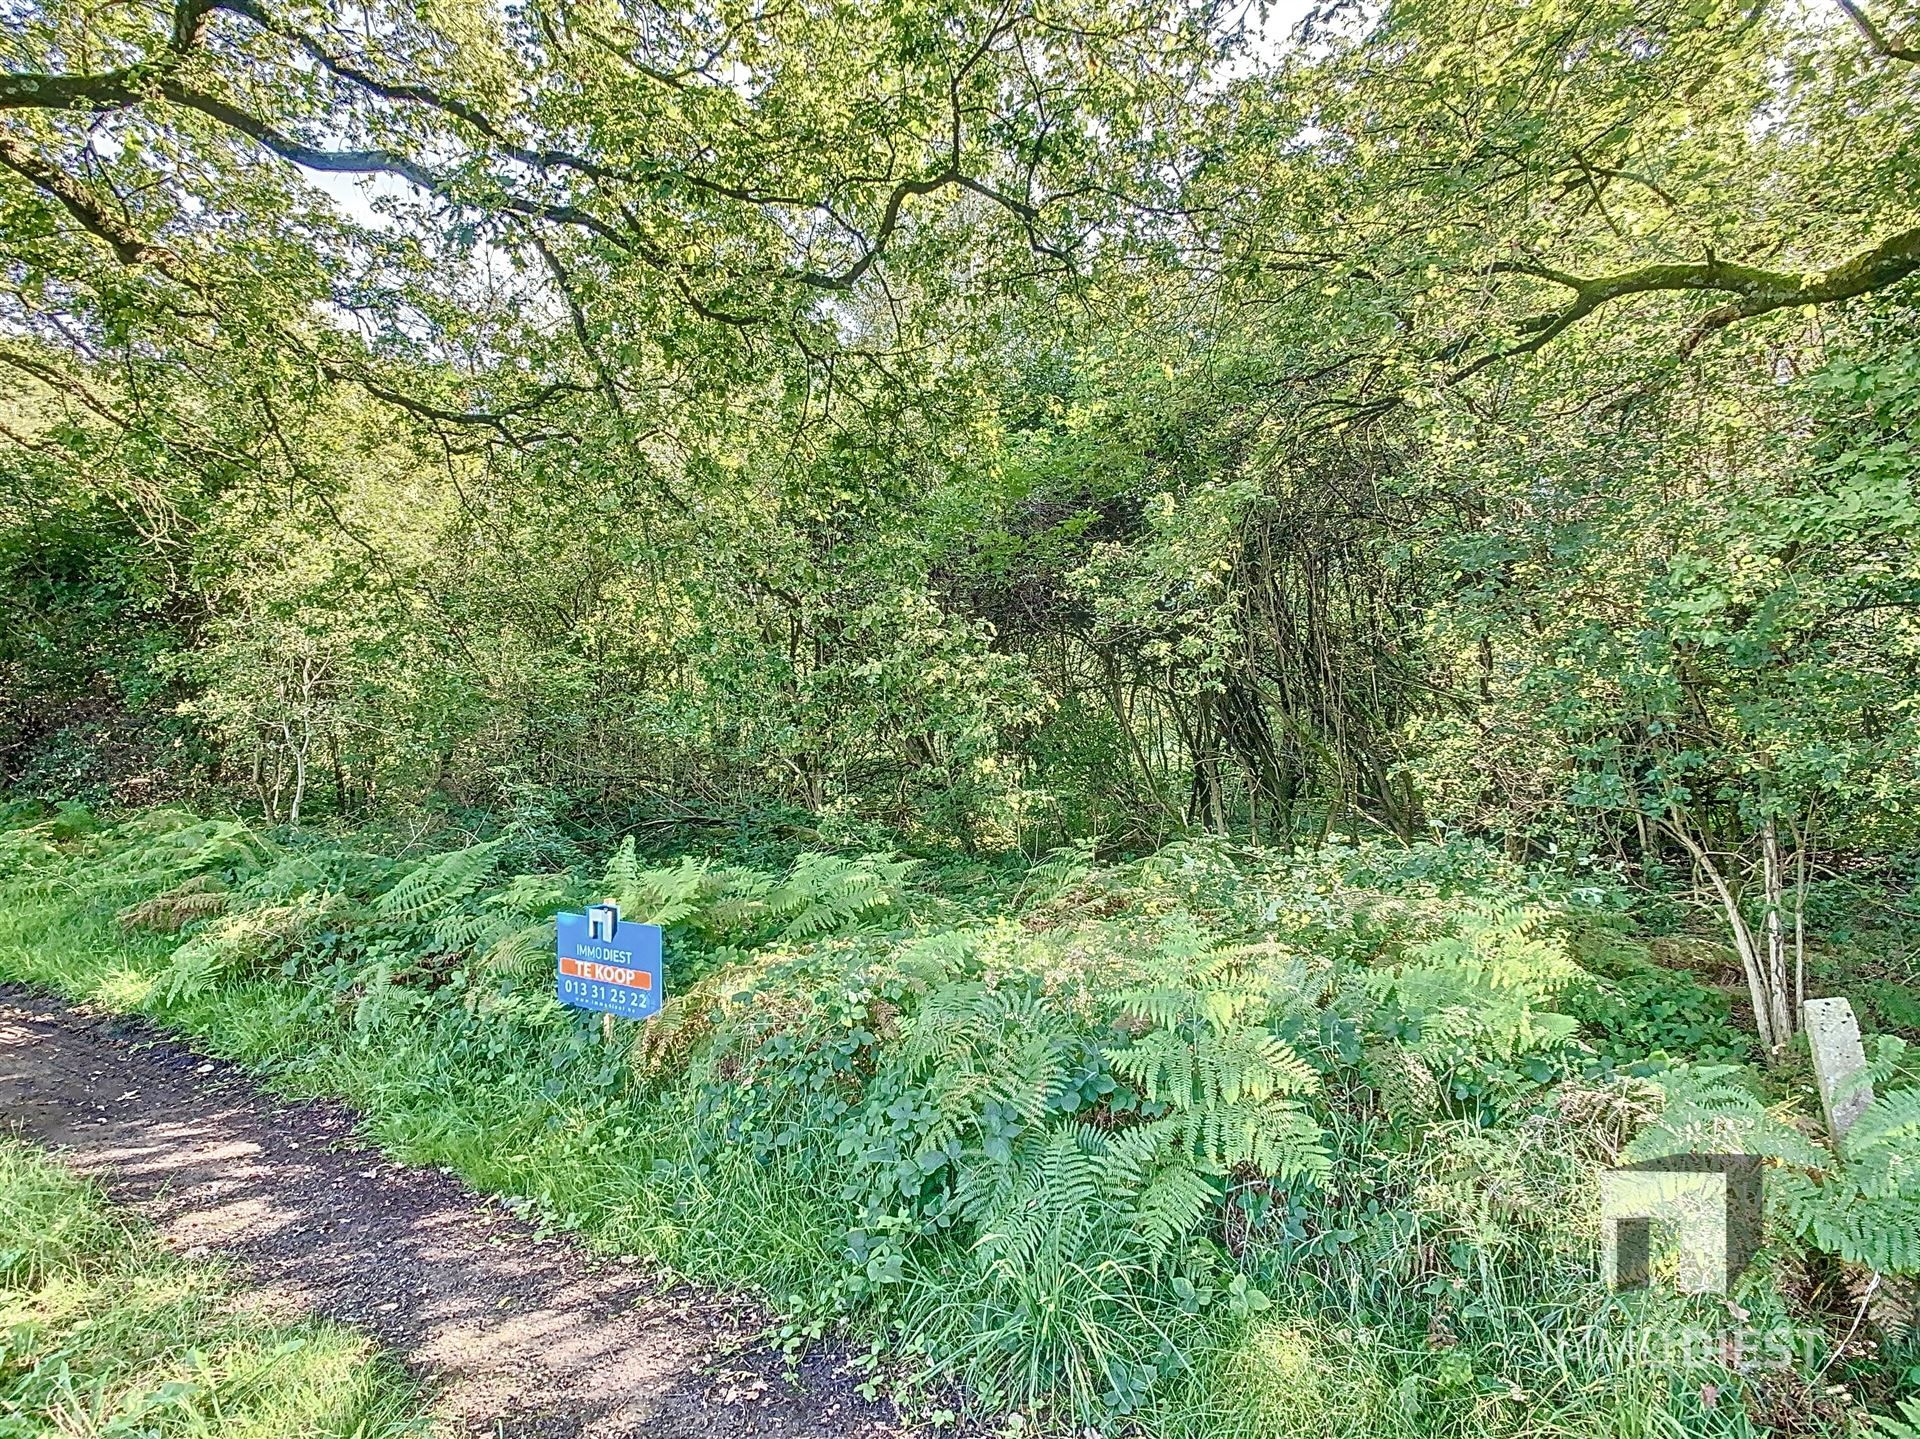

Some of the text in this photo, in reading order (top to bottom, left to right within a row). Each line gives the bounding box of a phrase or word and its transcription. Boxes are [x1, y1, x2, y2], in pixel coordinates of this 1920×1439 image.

[576, 944, 632, 964] IMMO DIEST
[575, 960, 635, 985] TE KOOP
[565, 980, 647, 1008] 013 31 25 22
